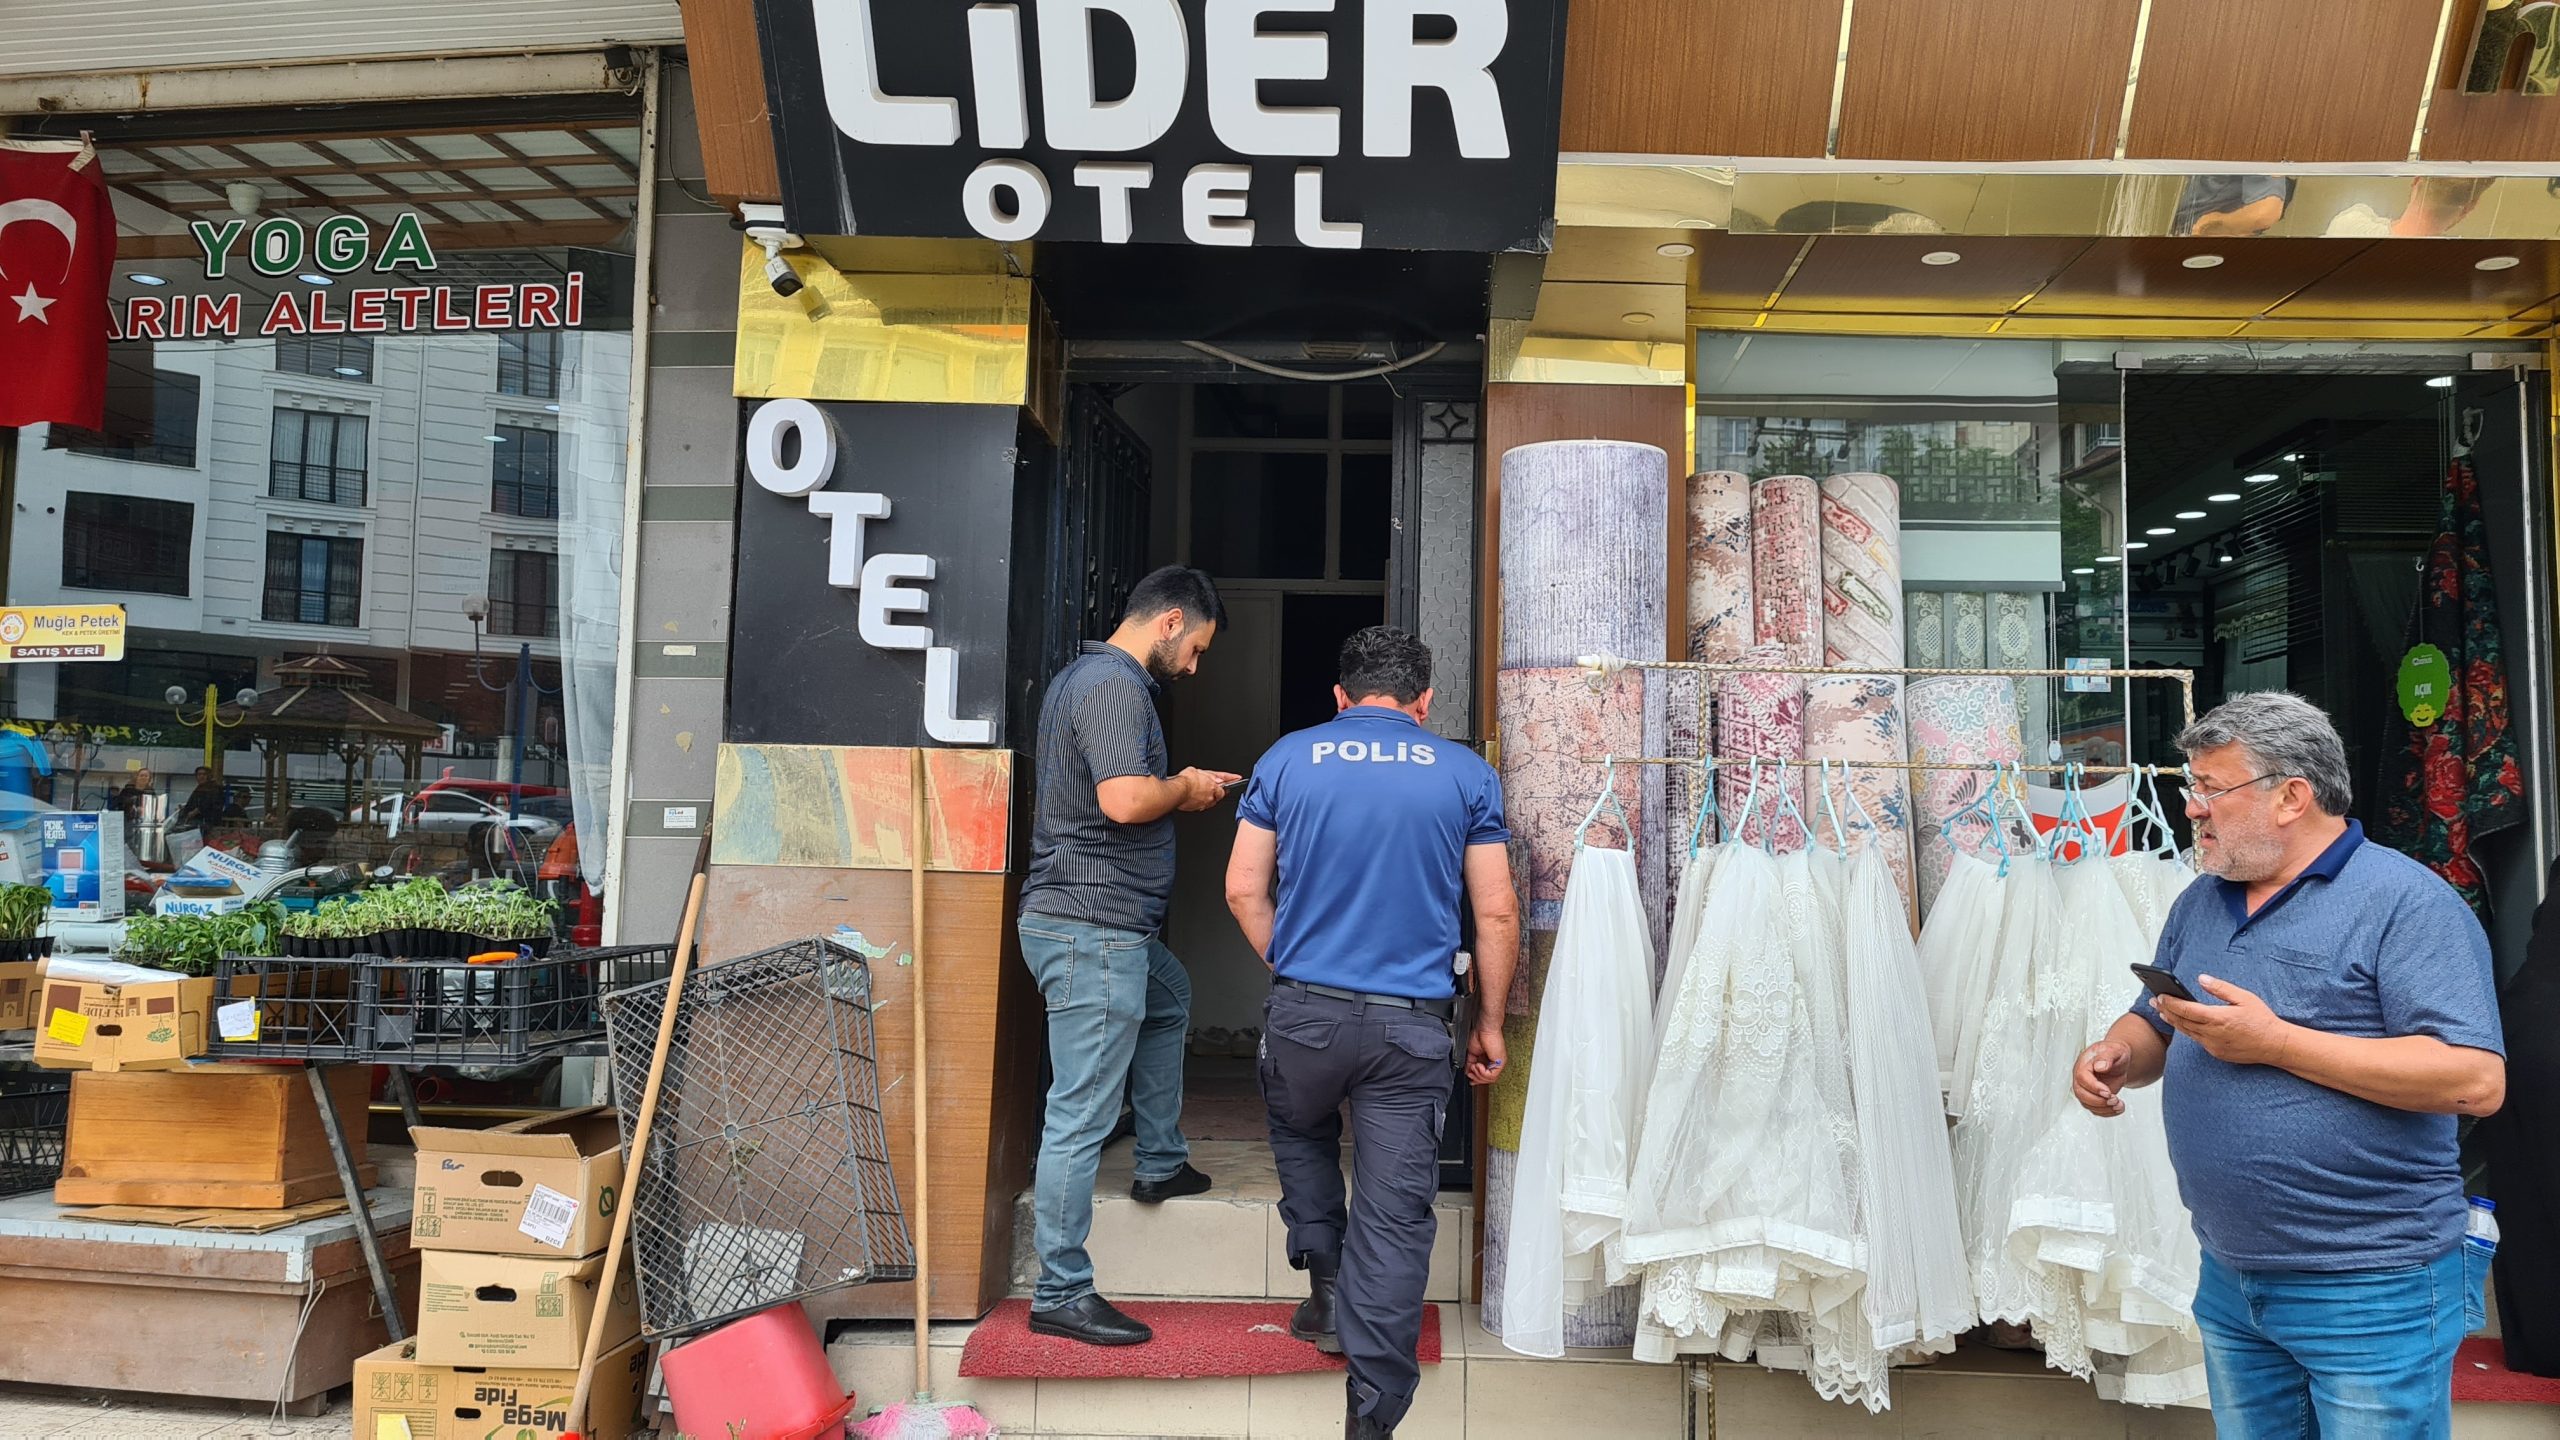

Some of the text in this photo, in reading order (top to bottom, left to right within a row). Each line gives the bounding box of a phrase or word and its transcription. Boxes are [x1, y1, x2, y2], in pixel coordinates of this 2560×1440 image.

[962, 158, 1364, 250] OTEL
[189, 212, 437, 279] YOGA
[260, 271, 584, 335] ALETLERİ
[746, 398, 996, 744] OTEL
[33, 615, 75, 631] Muğla
[80, 613, 120, 628] Petek
[17, 644, 100, 657] SATIŞ YERİ
[43, 820, 64, 831] PICNIC
[44, 830, 67, 839] HEATER
[207, 851, 261, 878] NURGAZ
[165, 901, 213, 915] NURGAZ
[474, 1387, 517, 1407] Fide
[503, 1404, 567, 1432] Mega
